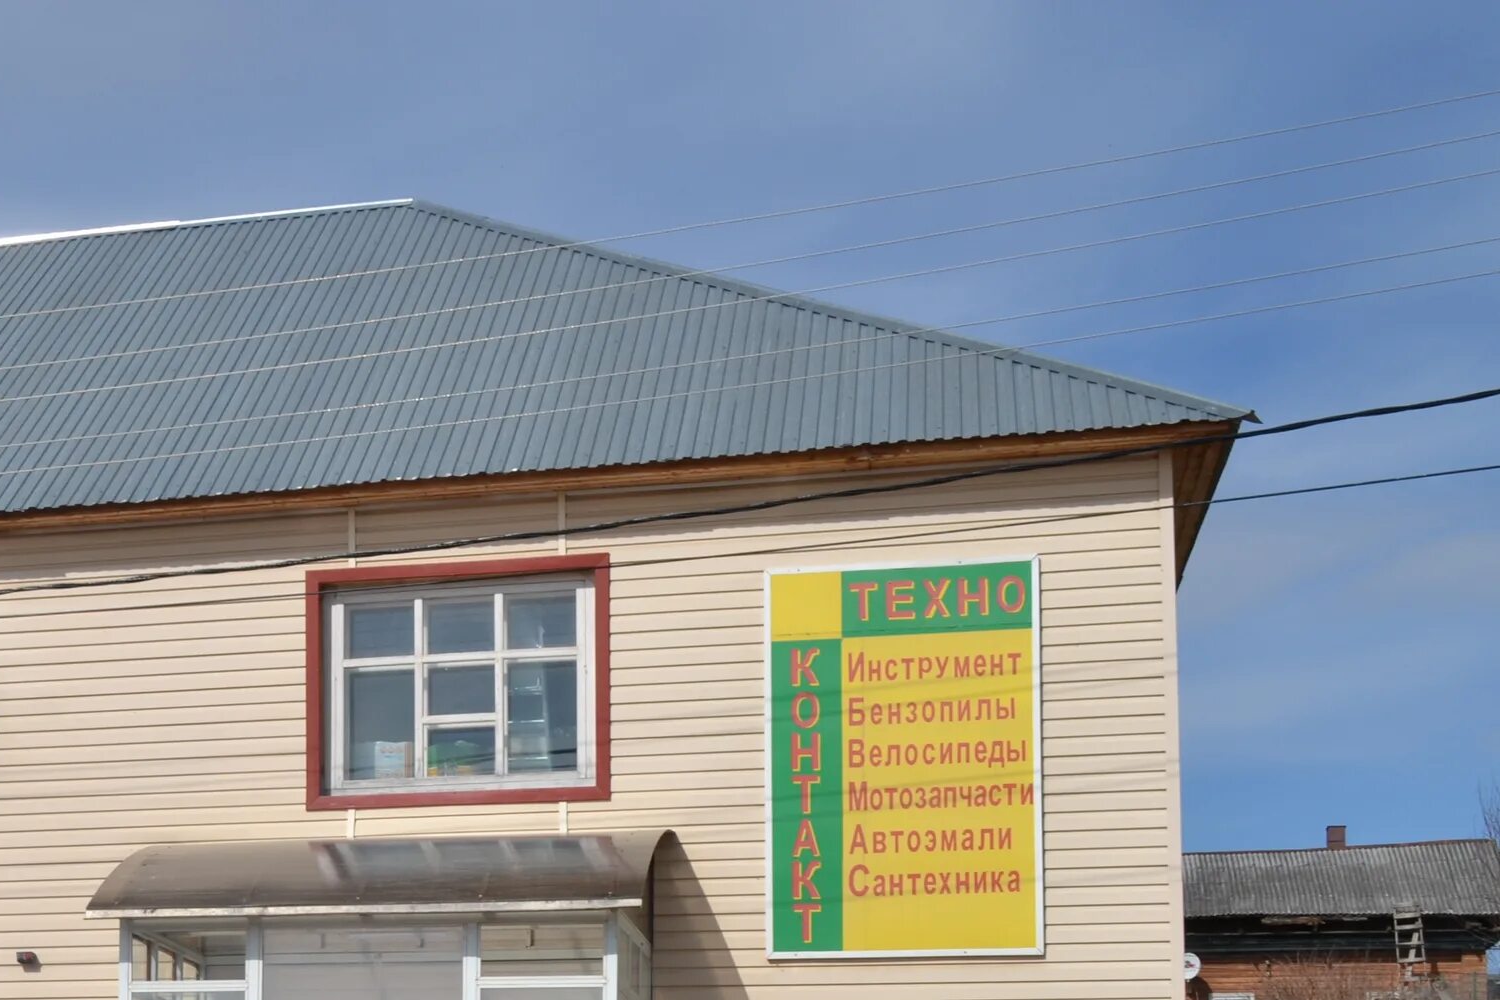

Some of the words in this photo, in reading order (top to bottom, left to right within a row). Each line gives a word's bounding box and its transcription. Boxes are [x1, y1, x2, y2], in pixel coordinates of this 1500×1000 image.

[849, 575, 1026, 621] ТЕХНО
[847, 651, 1023, 683] Инструмент
[847, 697, 1017, 728] Бензопилы
[847, 739, 1028, 769] Велосипеды
[790, 647, 822, 943] КОНТАКТ
[847, 781, 1035, 812] Мотозапчасти
[848, 823, 1013, 855] Автоэмали
[847, 863, 1022, 897] Сантехника
